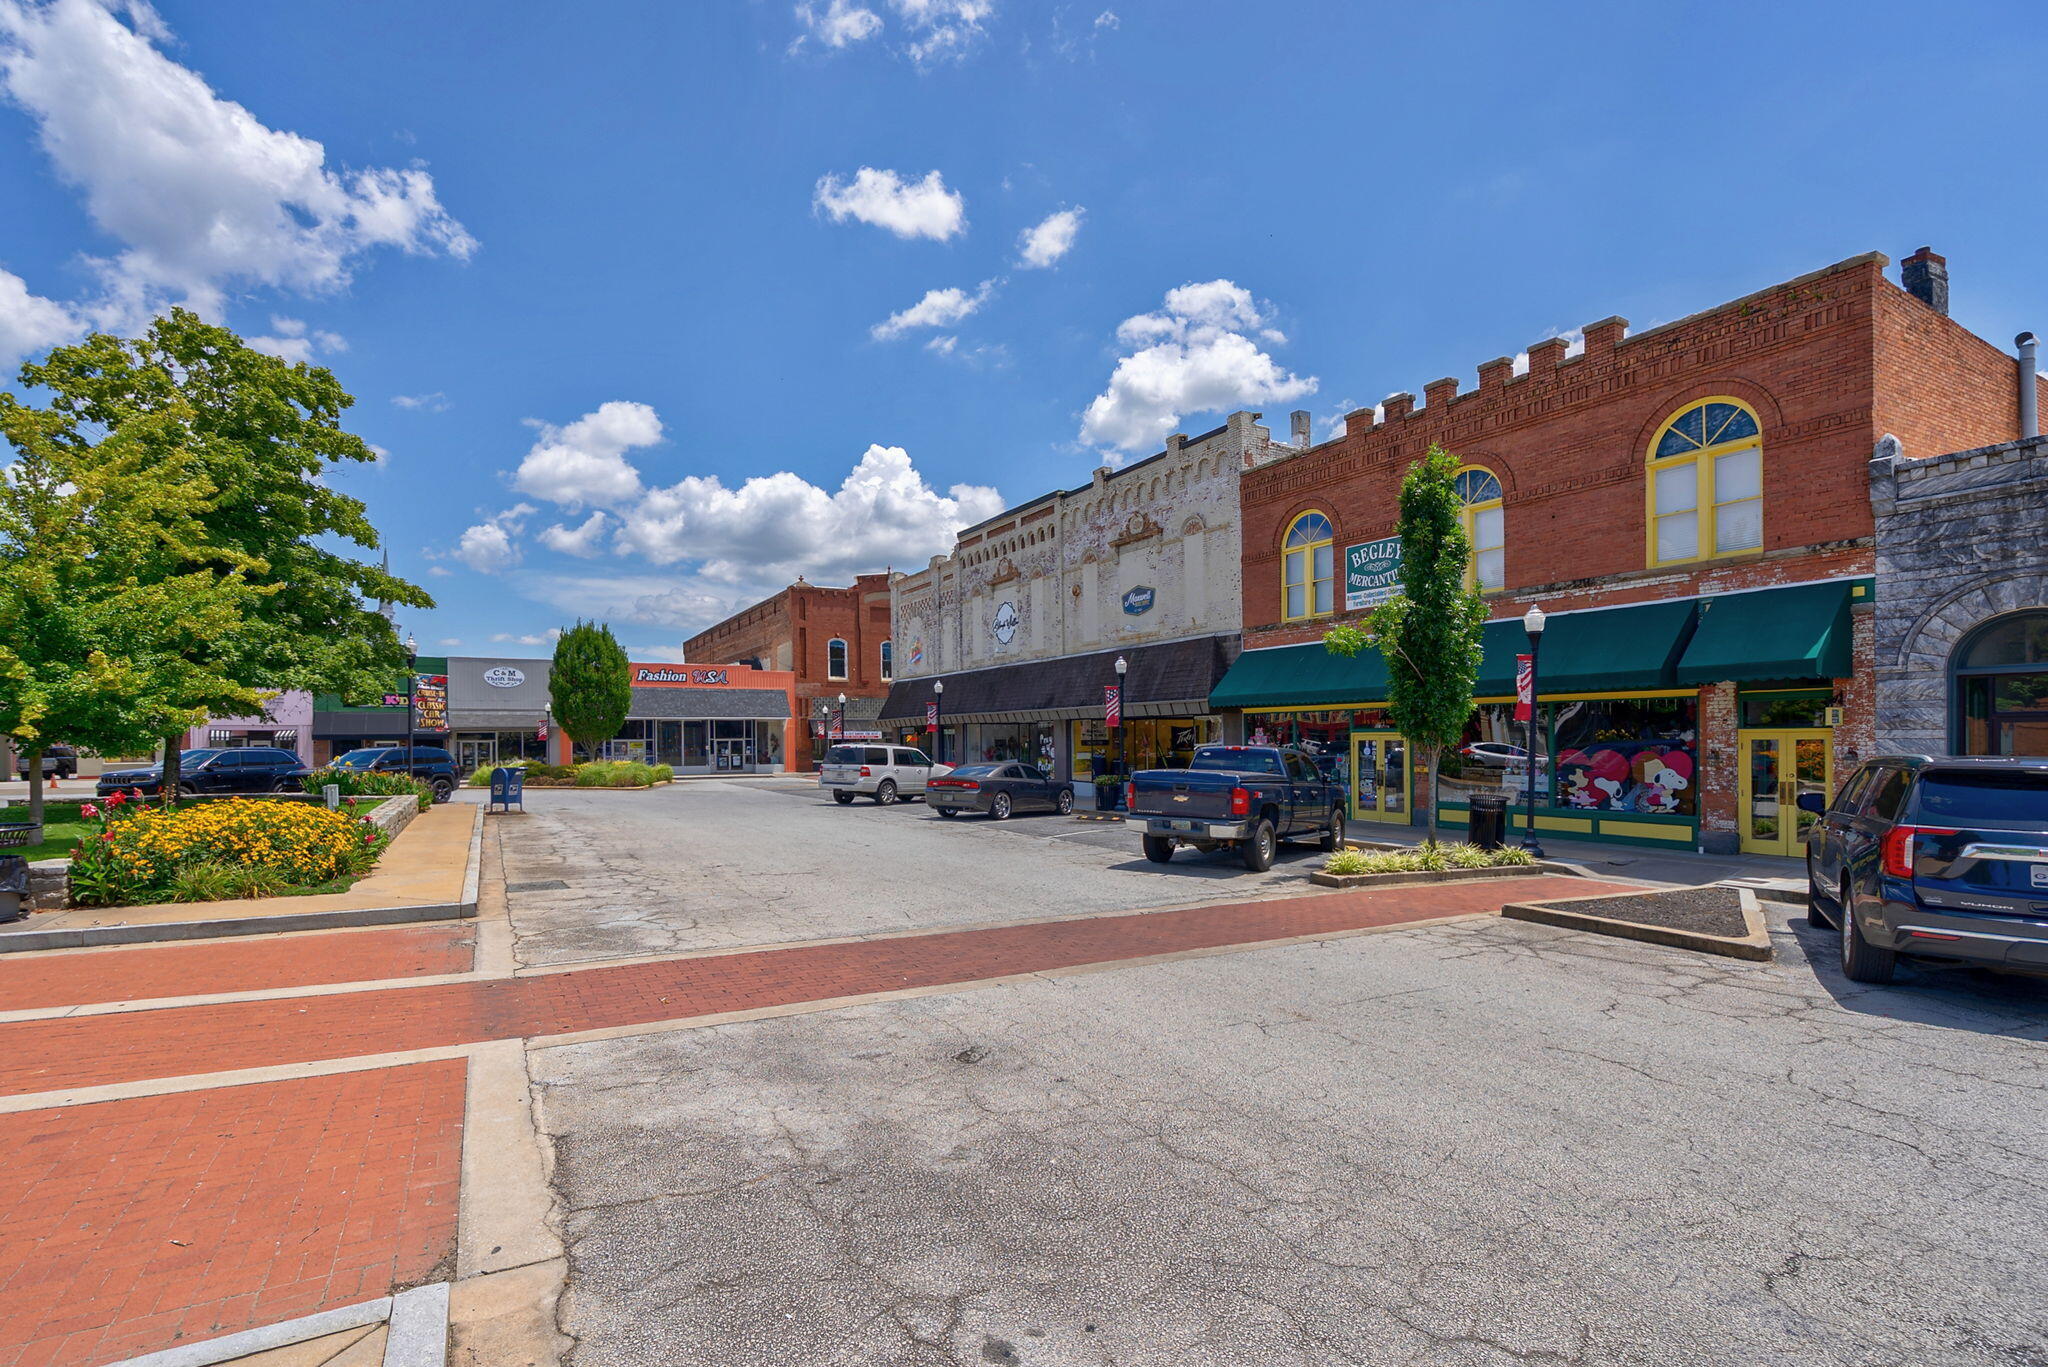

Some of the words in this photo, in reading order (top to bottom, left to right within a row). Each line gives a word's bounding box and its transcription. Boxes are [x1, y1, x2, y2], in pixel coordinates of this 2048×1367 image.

[1351, 543, 1401, 568] BEGLEY
[1125, 591, 1151, 607] Maxwell
[637, 669, 687, 682] Fashion
[692, 669, 729, 684] USA
[417, 700, 446, 710] CLASSIC
[424, 709, 440, 718] CAR
[420, 718, 445, 727] SHOW
